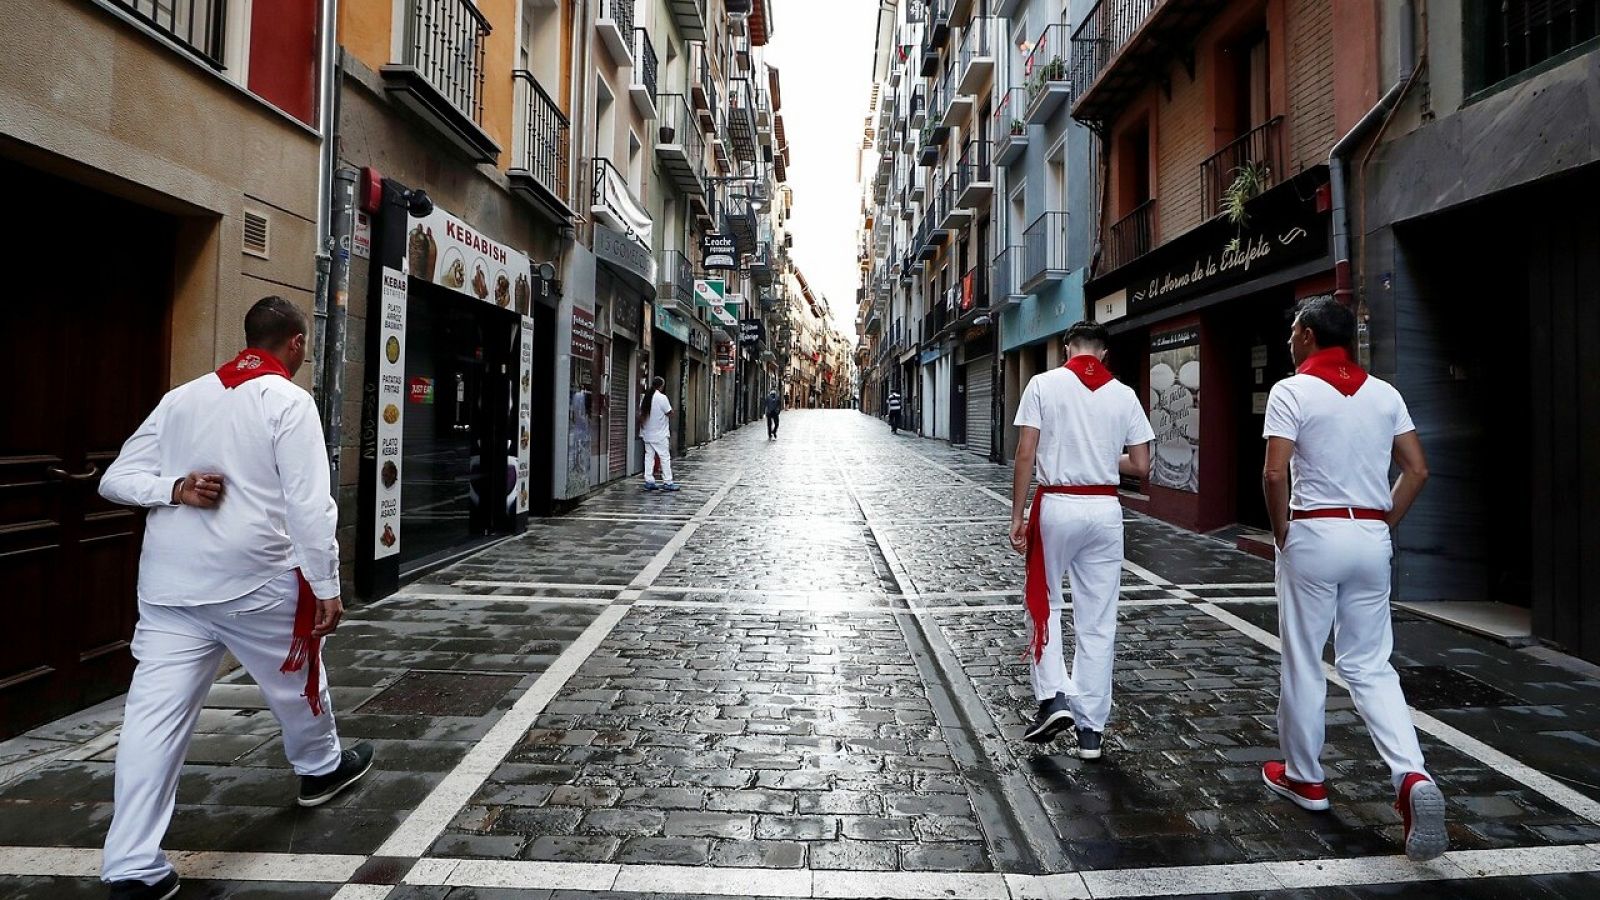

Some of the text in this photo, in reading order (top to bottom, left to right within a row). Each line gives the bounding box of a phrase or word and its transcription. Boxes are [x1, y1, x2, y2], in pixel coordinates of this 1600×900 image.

[446, 220, 507, 265] KEBABISH
[704, 236, 732, 246] Leache
[1148, 234, 1271, 298] El Horno de la Estafeta
[384, 275, 406, 292] KEBAB
[387, 303, 401, 313] PLATO
[382, 374, 402, 384] PATATAS
[383, 385, 400, 394] FRITAS
[410, 384, 423, 395] JUST
[382, 438, 398, 447] PLATO
[381, 499, 397, 509] POLLO
